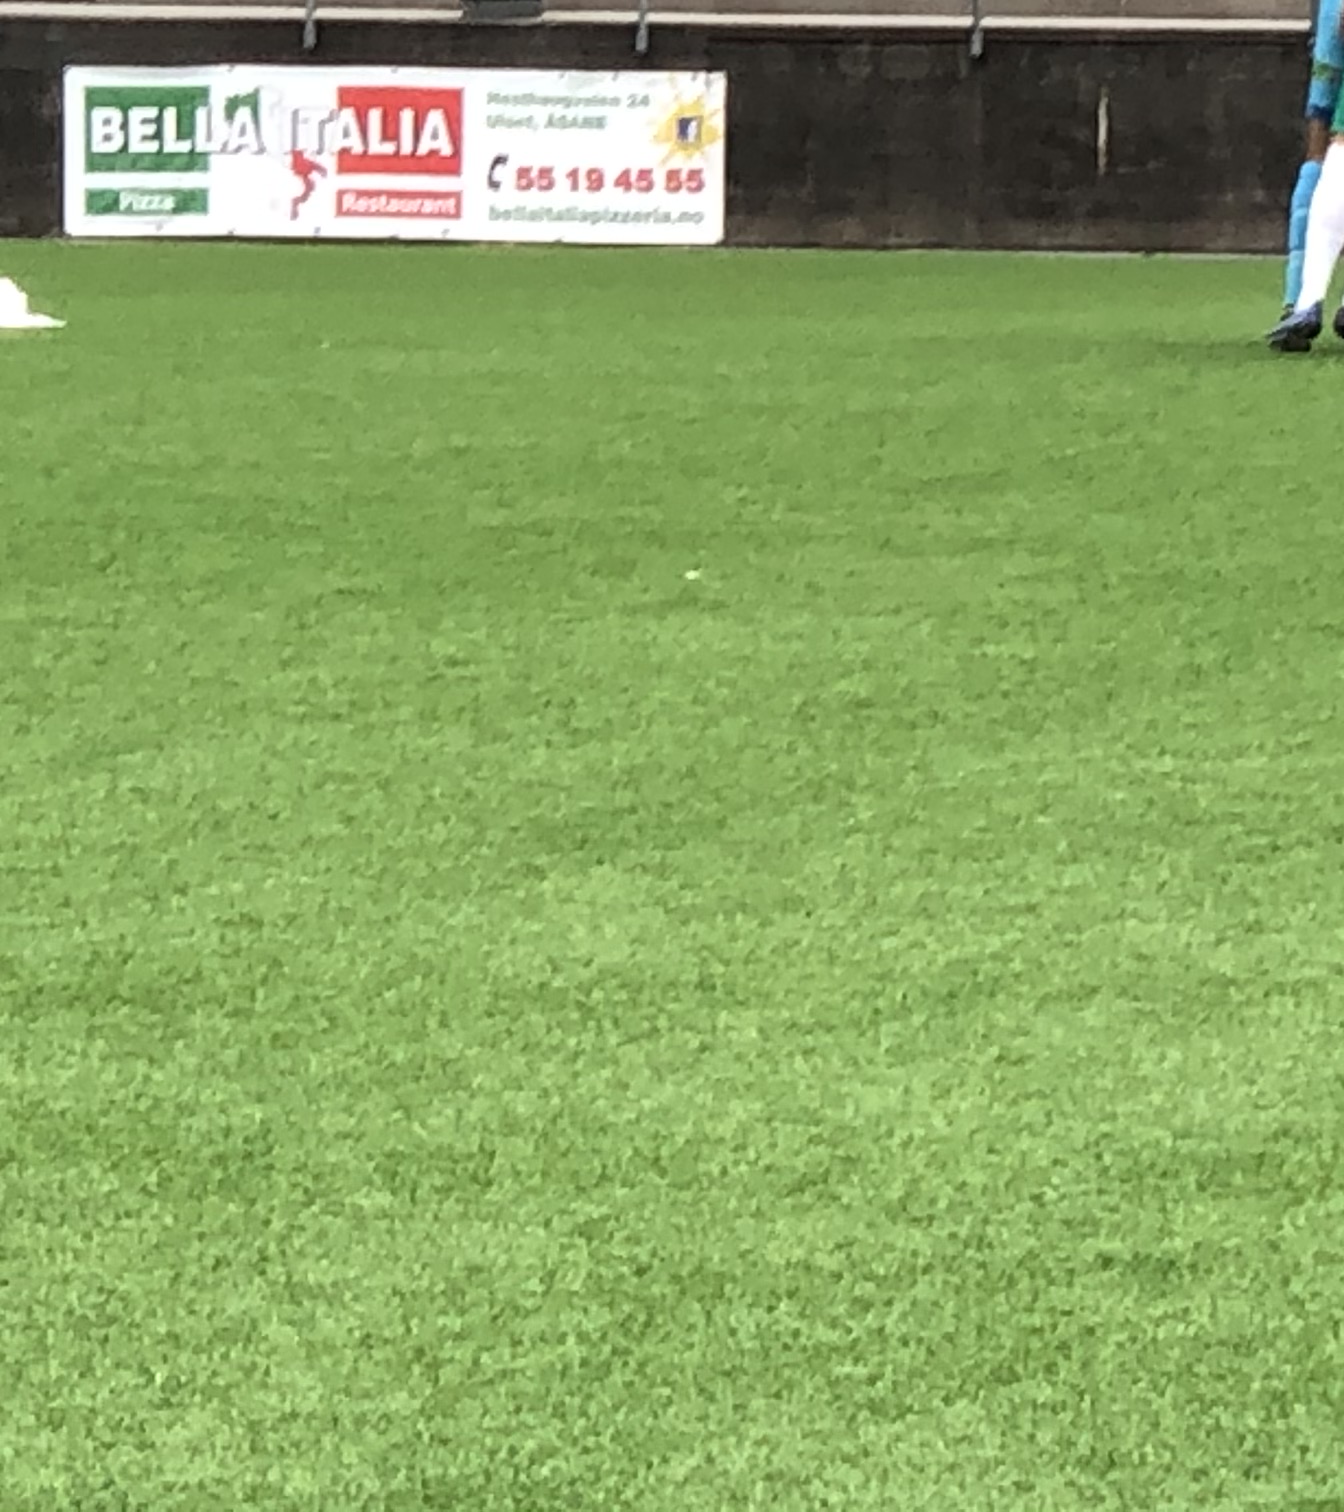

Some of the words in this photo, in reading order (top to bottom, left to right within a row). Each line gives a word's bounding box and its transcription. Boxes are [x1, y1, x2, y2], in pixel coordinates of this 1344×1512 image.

[90, 105, 265, 156] BELLA
[280, 105, 455, 158] ITALIA
[514, 165, 556, 192] 55
[565, 166, 606, 192] 19
[613, 167, 655, 194] 45
[118, 190, 177, 213] Pizza
[341, 191, 457, 215] Restaurant
